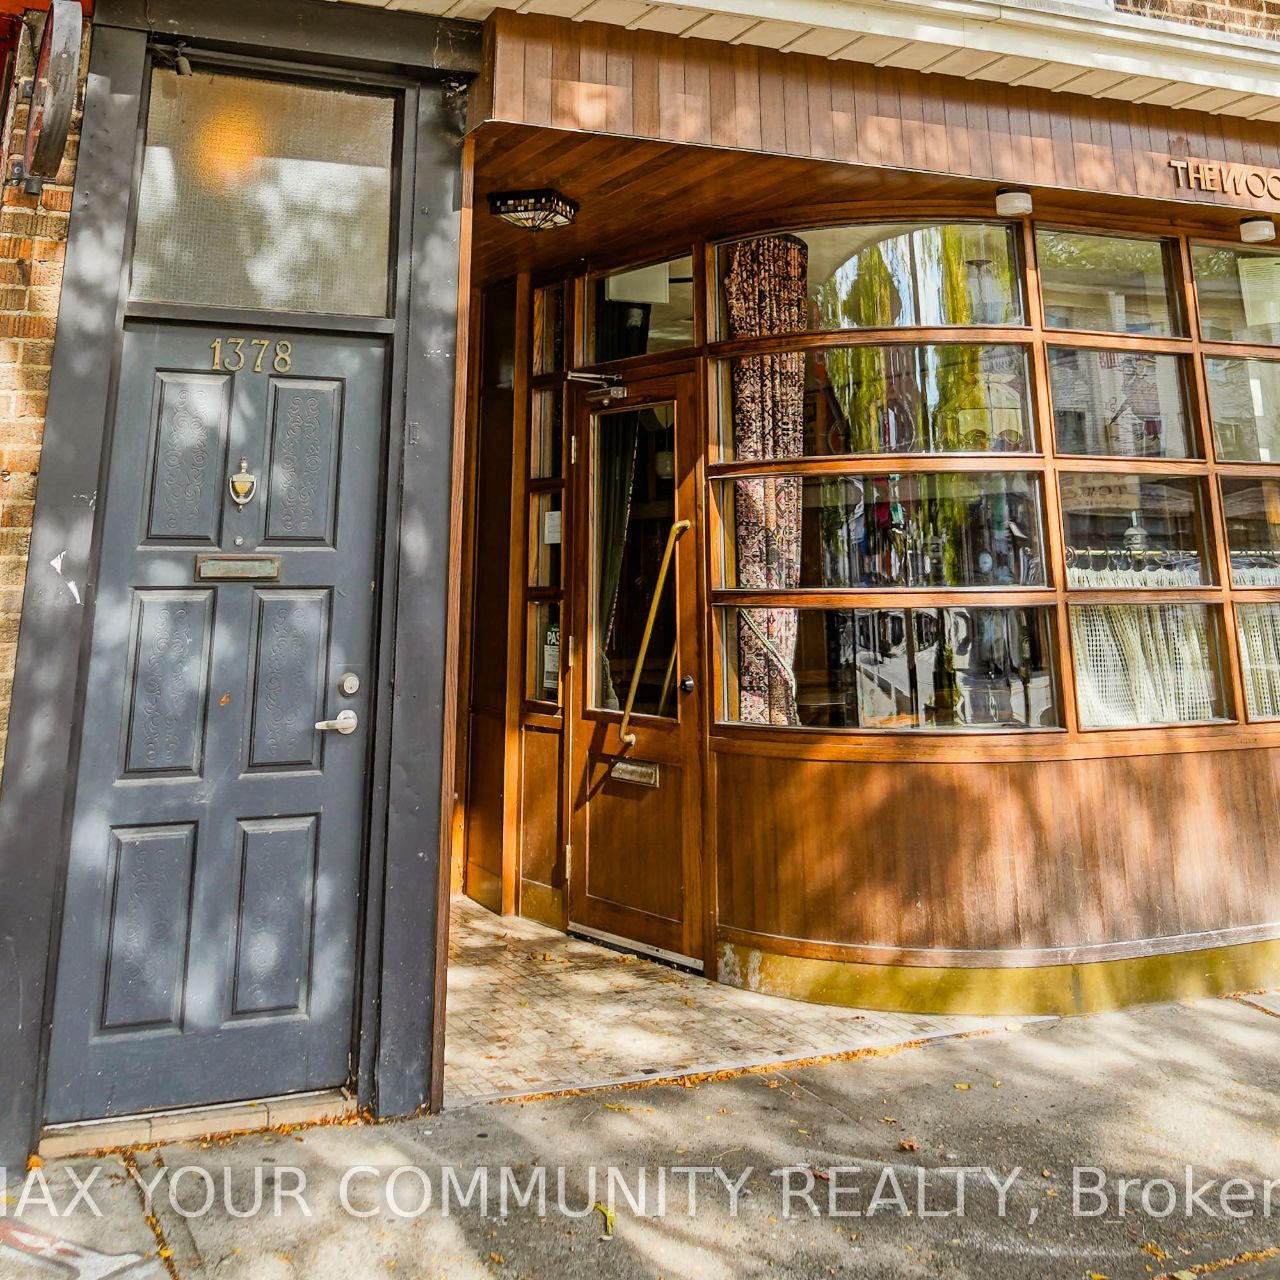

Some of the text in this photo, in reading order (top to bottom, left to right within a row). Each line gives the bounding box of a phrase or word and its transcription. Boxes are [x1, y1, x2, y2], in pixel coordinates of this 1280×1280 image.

[1170, 160, 1218, 192] THE
[211, 337, 292, 373] 1378
[547, 631, 560, 645] PAS
